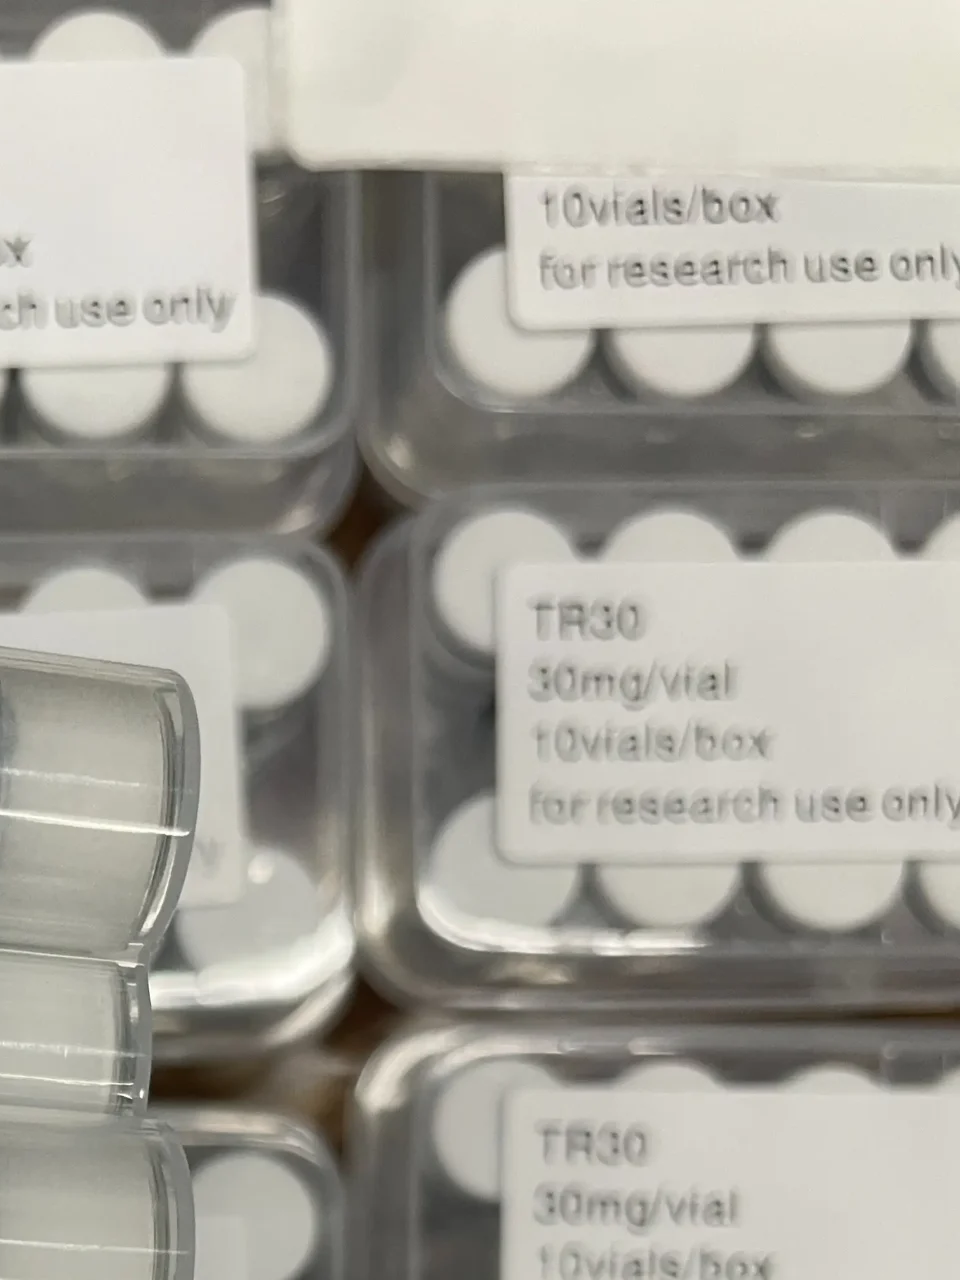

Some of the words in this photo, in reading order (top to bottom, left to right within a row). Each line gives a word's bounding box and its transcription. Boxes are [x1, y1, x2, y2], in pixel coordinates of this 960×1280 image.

[539, 184, 780, 229] 10vials/box
[539, 252, 598, 291] for
[606, 244, 794, 288] research
[803, 248, 882, 283] use
[54, 295, 136, 330] use
[141, 282, 237, 333] only
[528, 595, 649, 642] TR30
[527, 652, 742, 711] 30mg/vial
[529, 717, 776, 763] 10vials/box
[527, 780, 588, 826] for
[595, 779, 784, 825] research
[793, 787, 877, 823] use
[533, 1118, 653, 1167] TR30
[533, 1180, 747, 1236] 30mg/vial
